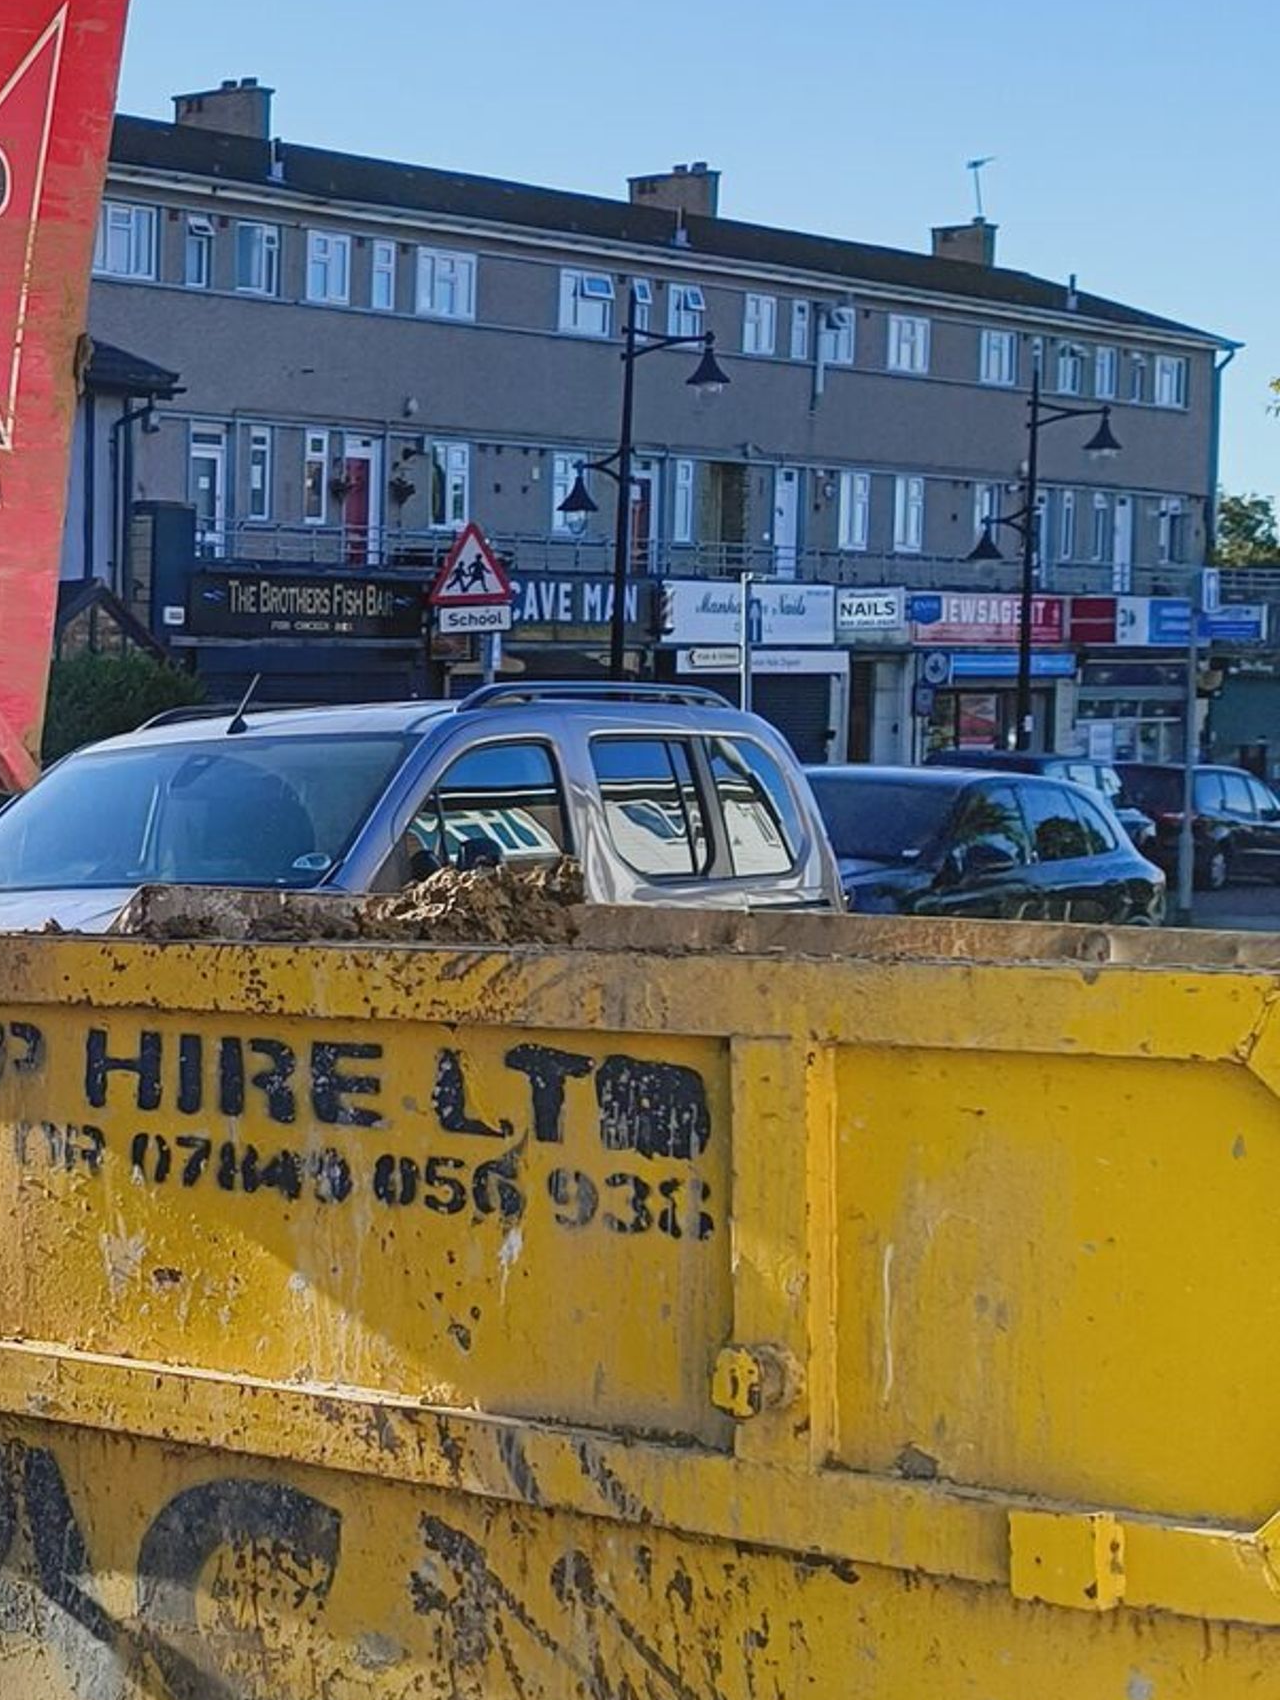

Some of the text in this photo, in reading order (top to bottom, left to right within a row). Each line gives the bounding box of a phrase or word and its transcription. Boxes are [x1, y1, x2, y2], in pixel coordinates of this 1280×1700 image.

[228, 579, 258, 614] THE
[259, 580, 331, 615] BROTHERS
[332, 583, 365, 616] FISH
[840, 601, 896, 617] NAILS
[447, 609, 504, 628] School
[83, 1026, 388, 1130] HIRE
[430, 1041, 712, 1161] LTD
[373, 1152, 527, 1220] 056
